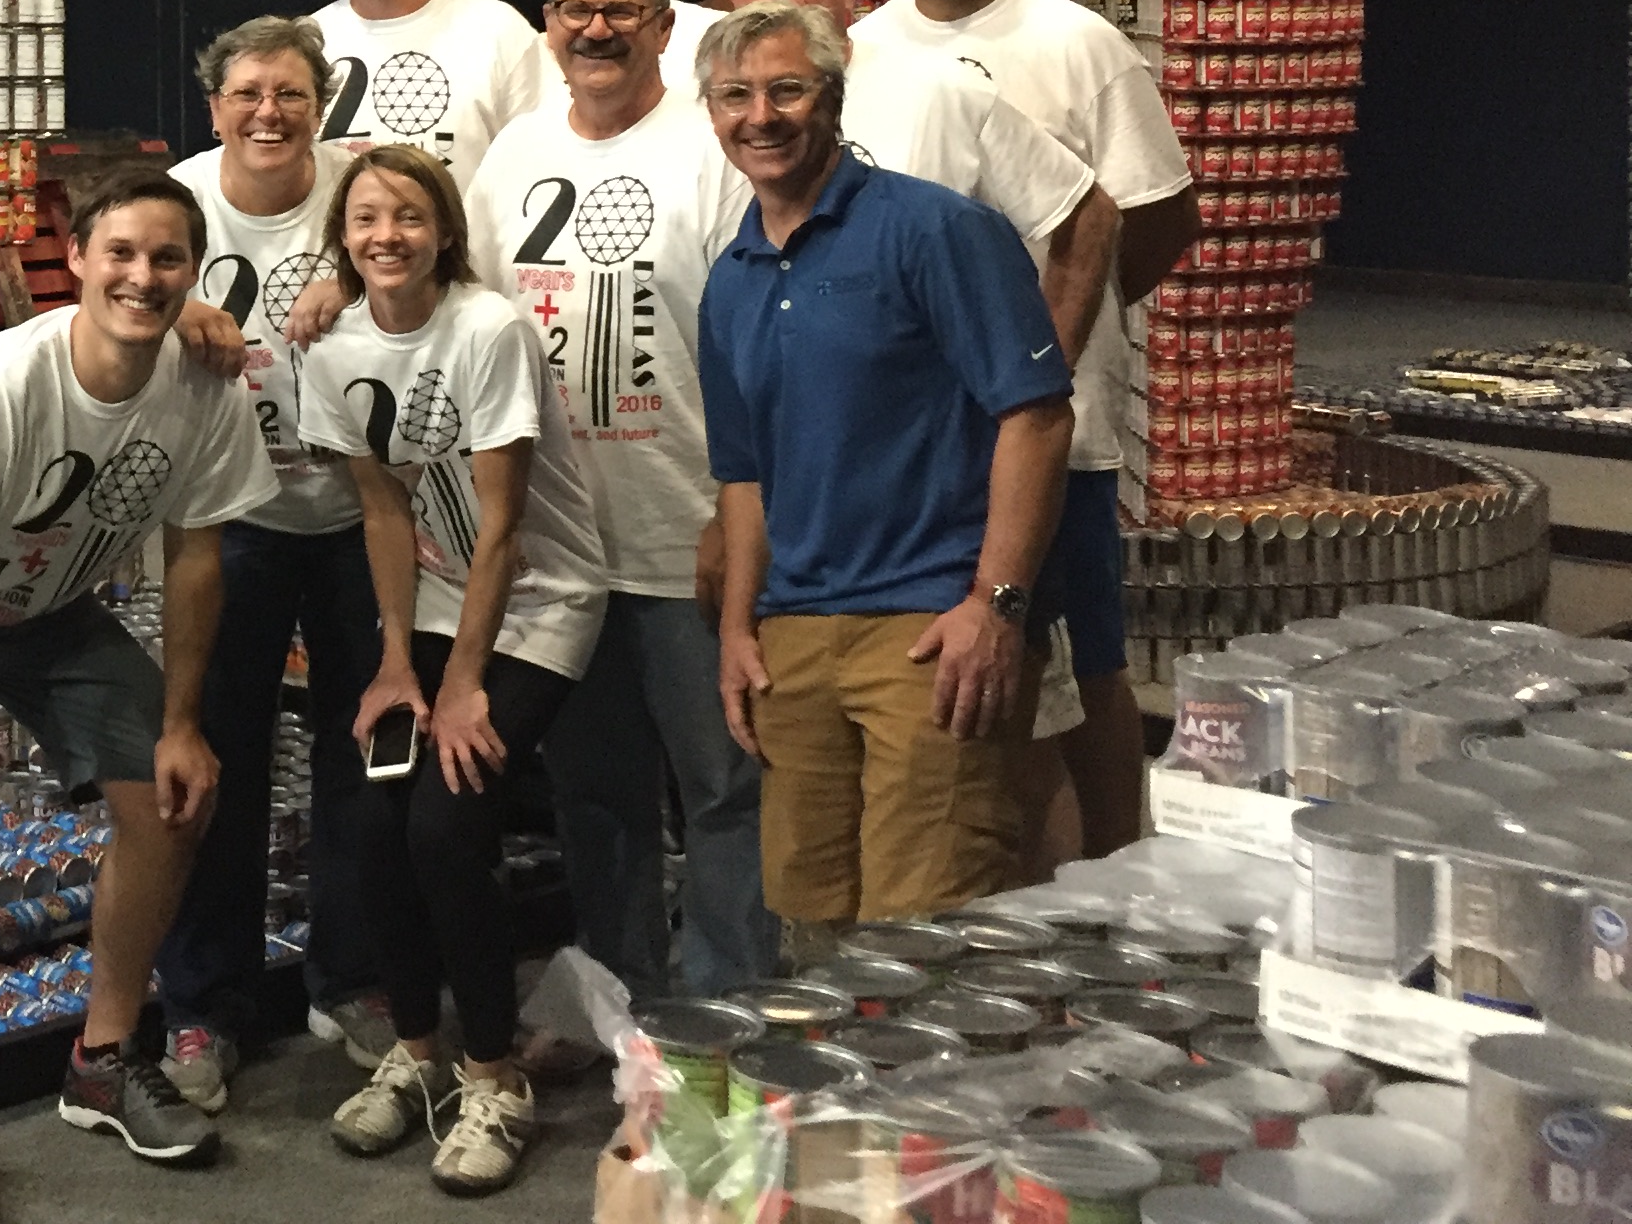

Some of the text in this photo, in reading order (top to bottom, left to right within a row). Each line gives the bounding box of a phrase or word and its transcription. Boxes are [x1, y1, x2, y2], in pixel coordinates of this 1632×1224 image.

[517, 269, 575, 293] years
[632, 260, 655, 387] DALLAS
[616, 394, 662, 413] 2016
[1180, 715, 1244, 747] ACK
